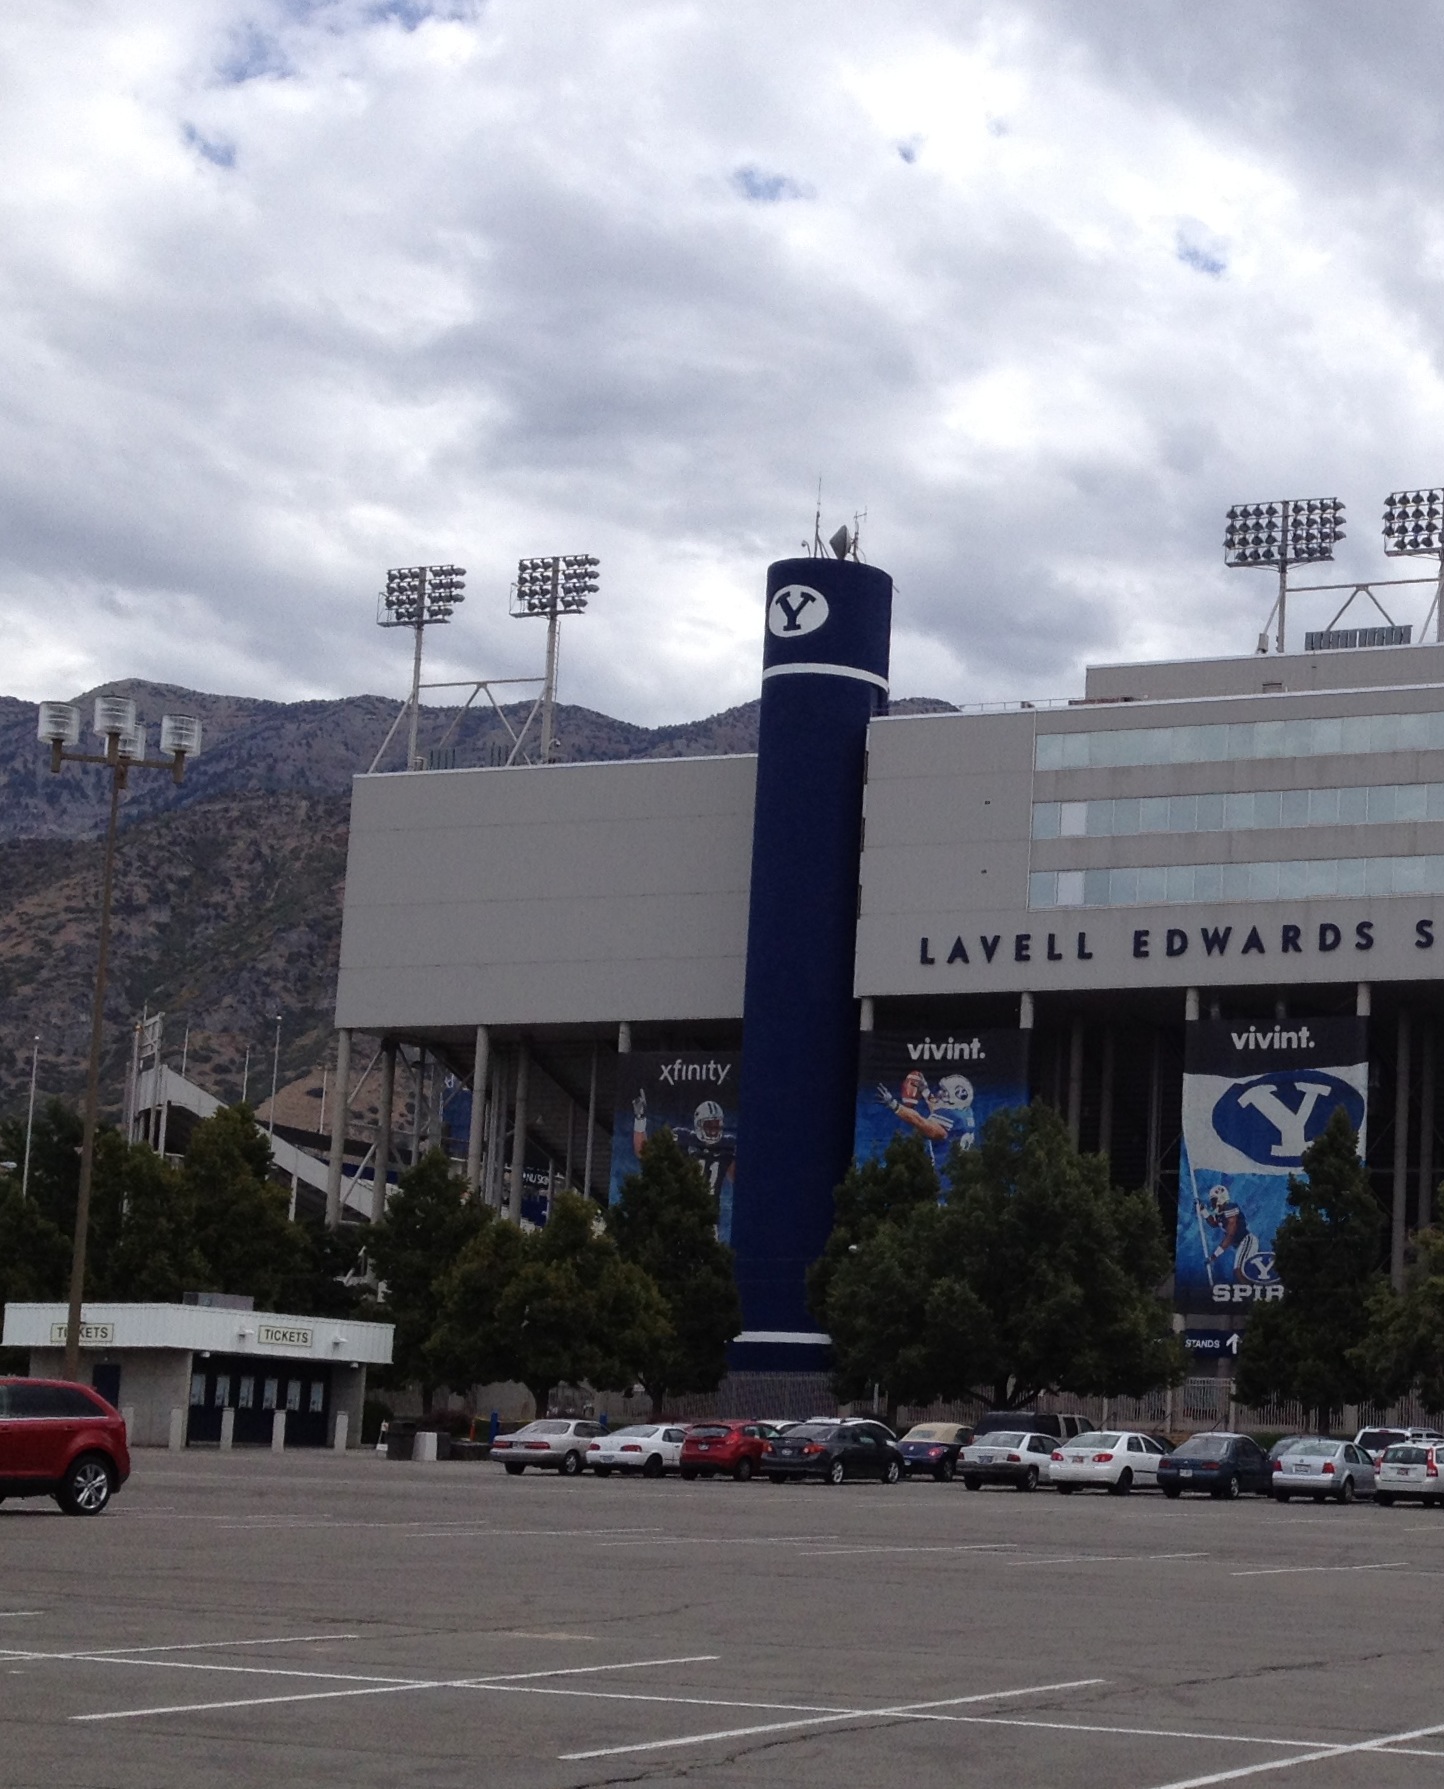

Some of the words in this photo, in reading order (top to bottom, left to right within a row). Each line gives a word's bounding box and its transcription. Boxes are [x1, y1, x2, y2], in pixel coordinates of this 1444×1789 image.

[775, 591, 816, 631] Y
[920, 931, 1094, 965] LAVELL
[1132, 920, 1374, 958] EDWARDS
[659, 1059, 732, 1086] xfinity
[56, 1327, 109, 1339] TIKETS
[264, 1329, 310, 1344] TICKETS
[1184, 1339, 1220, 1349] STANDS
